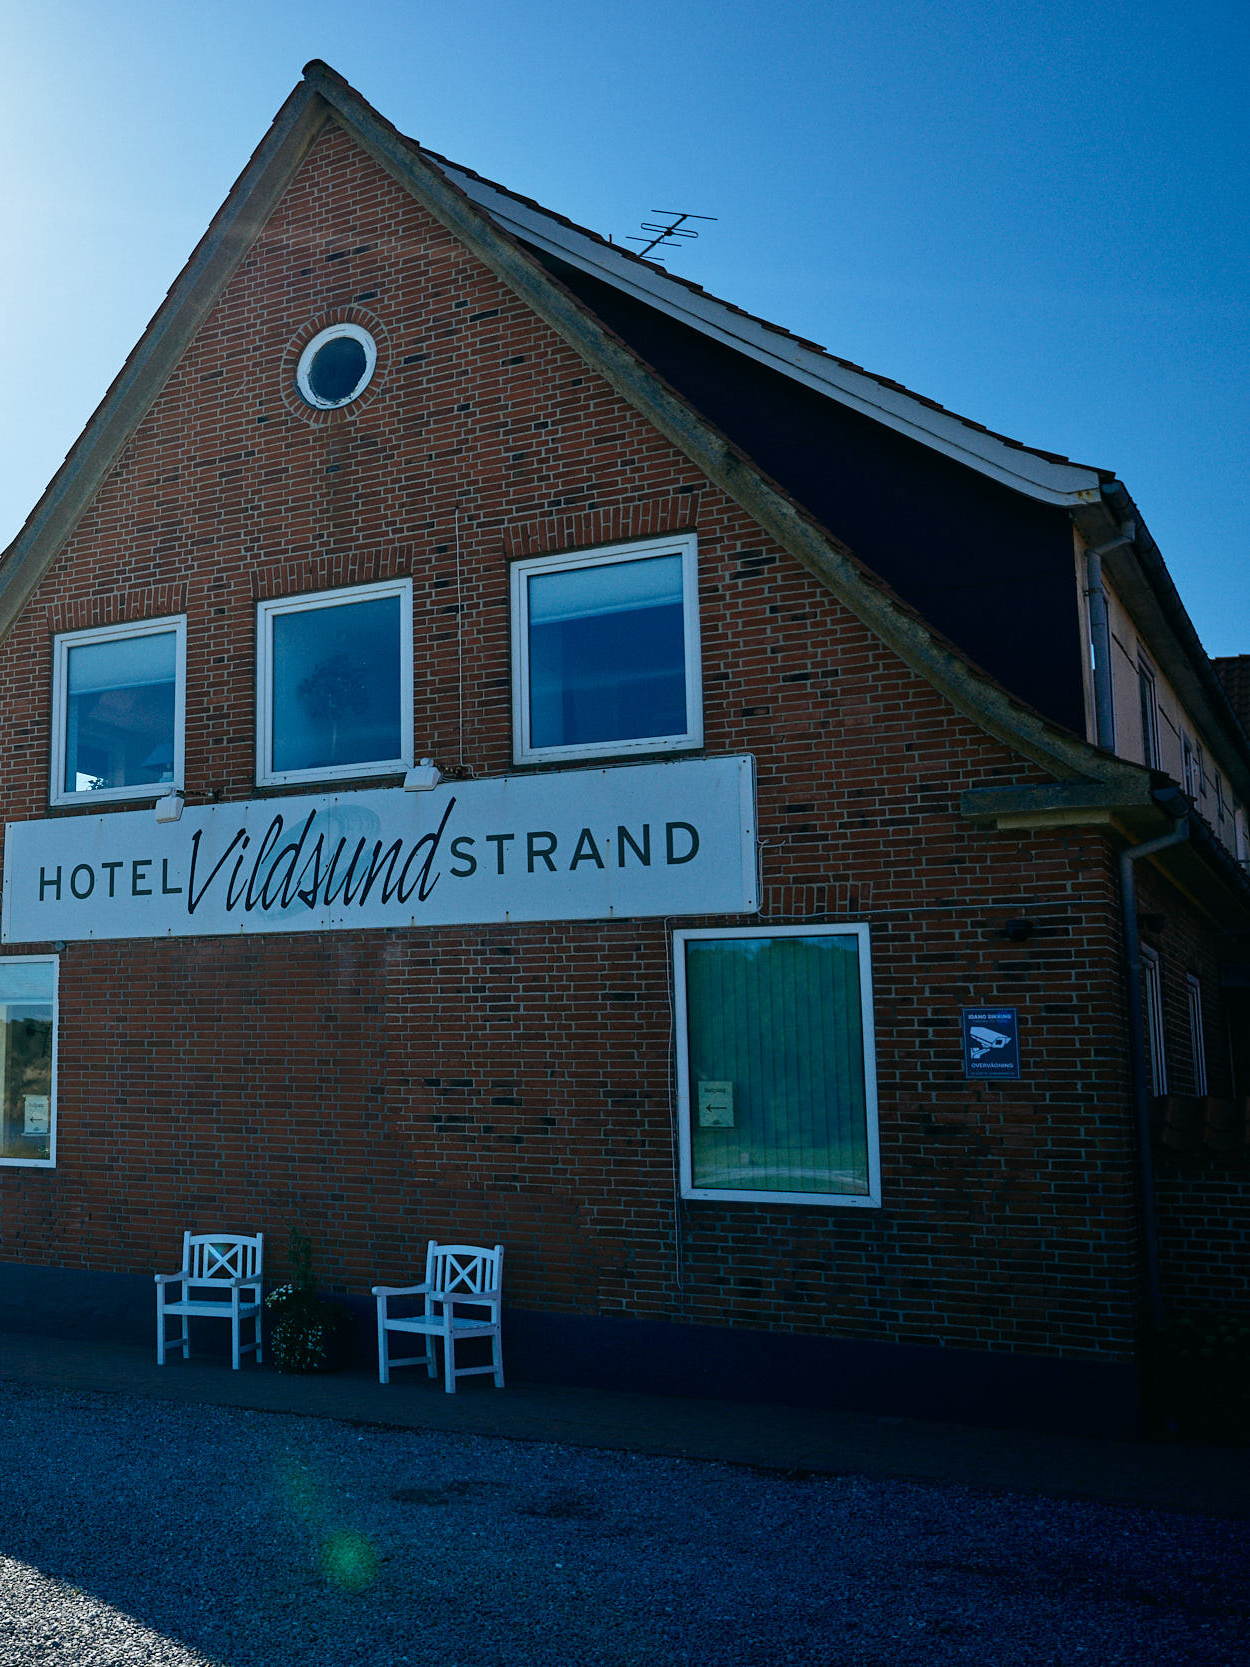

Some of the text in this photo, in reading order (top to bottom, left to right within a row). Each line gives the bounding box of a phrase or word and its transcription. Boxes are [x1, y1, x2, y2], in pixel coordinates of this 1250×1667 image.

[38, 796, 701, 915] HOTEL Vildsund STRAND
